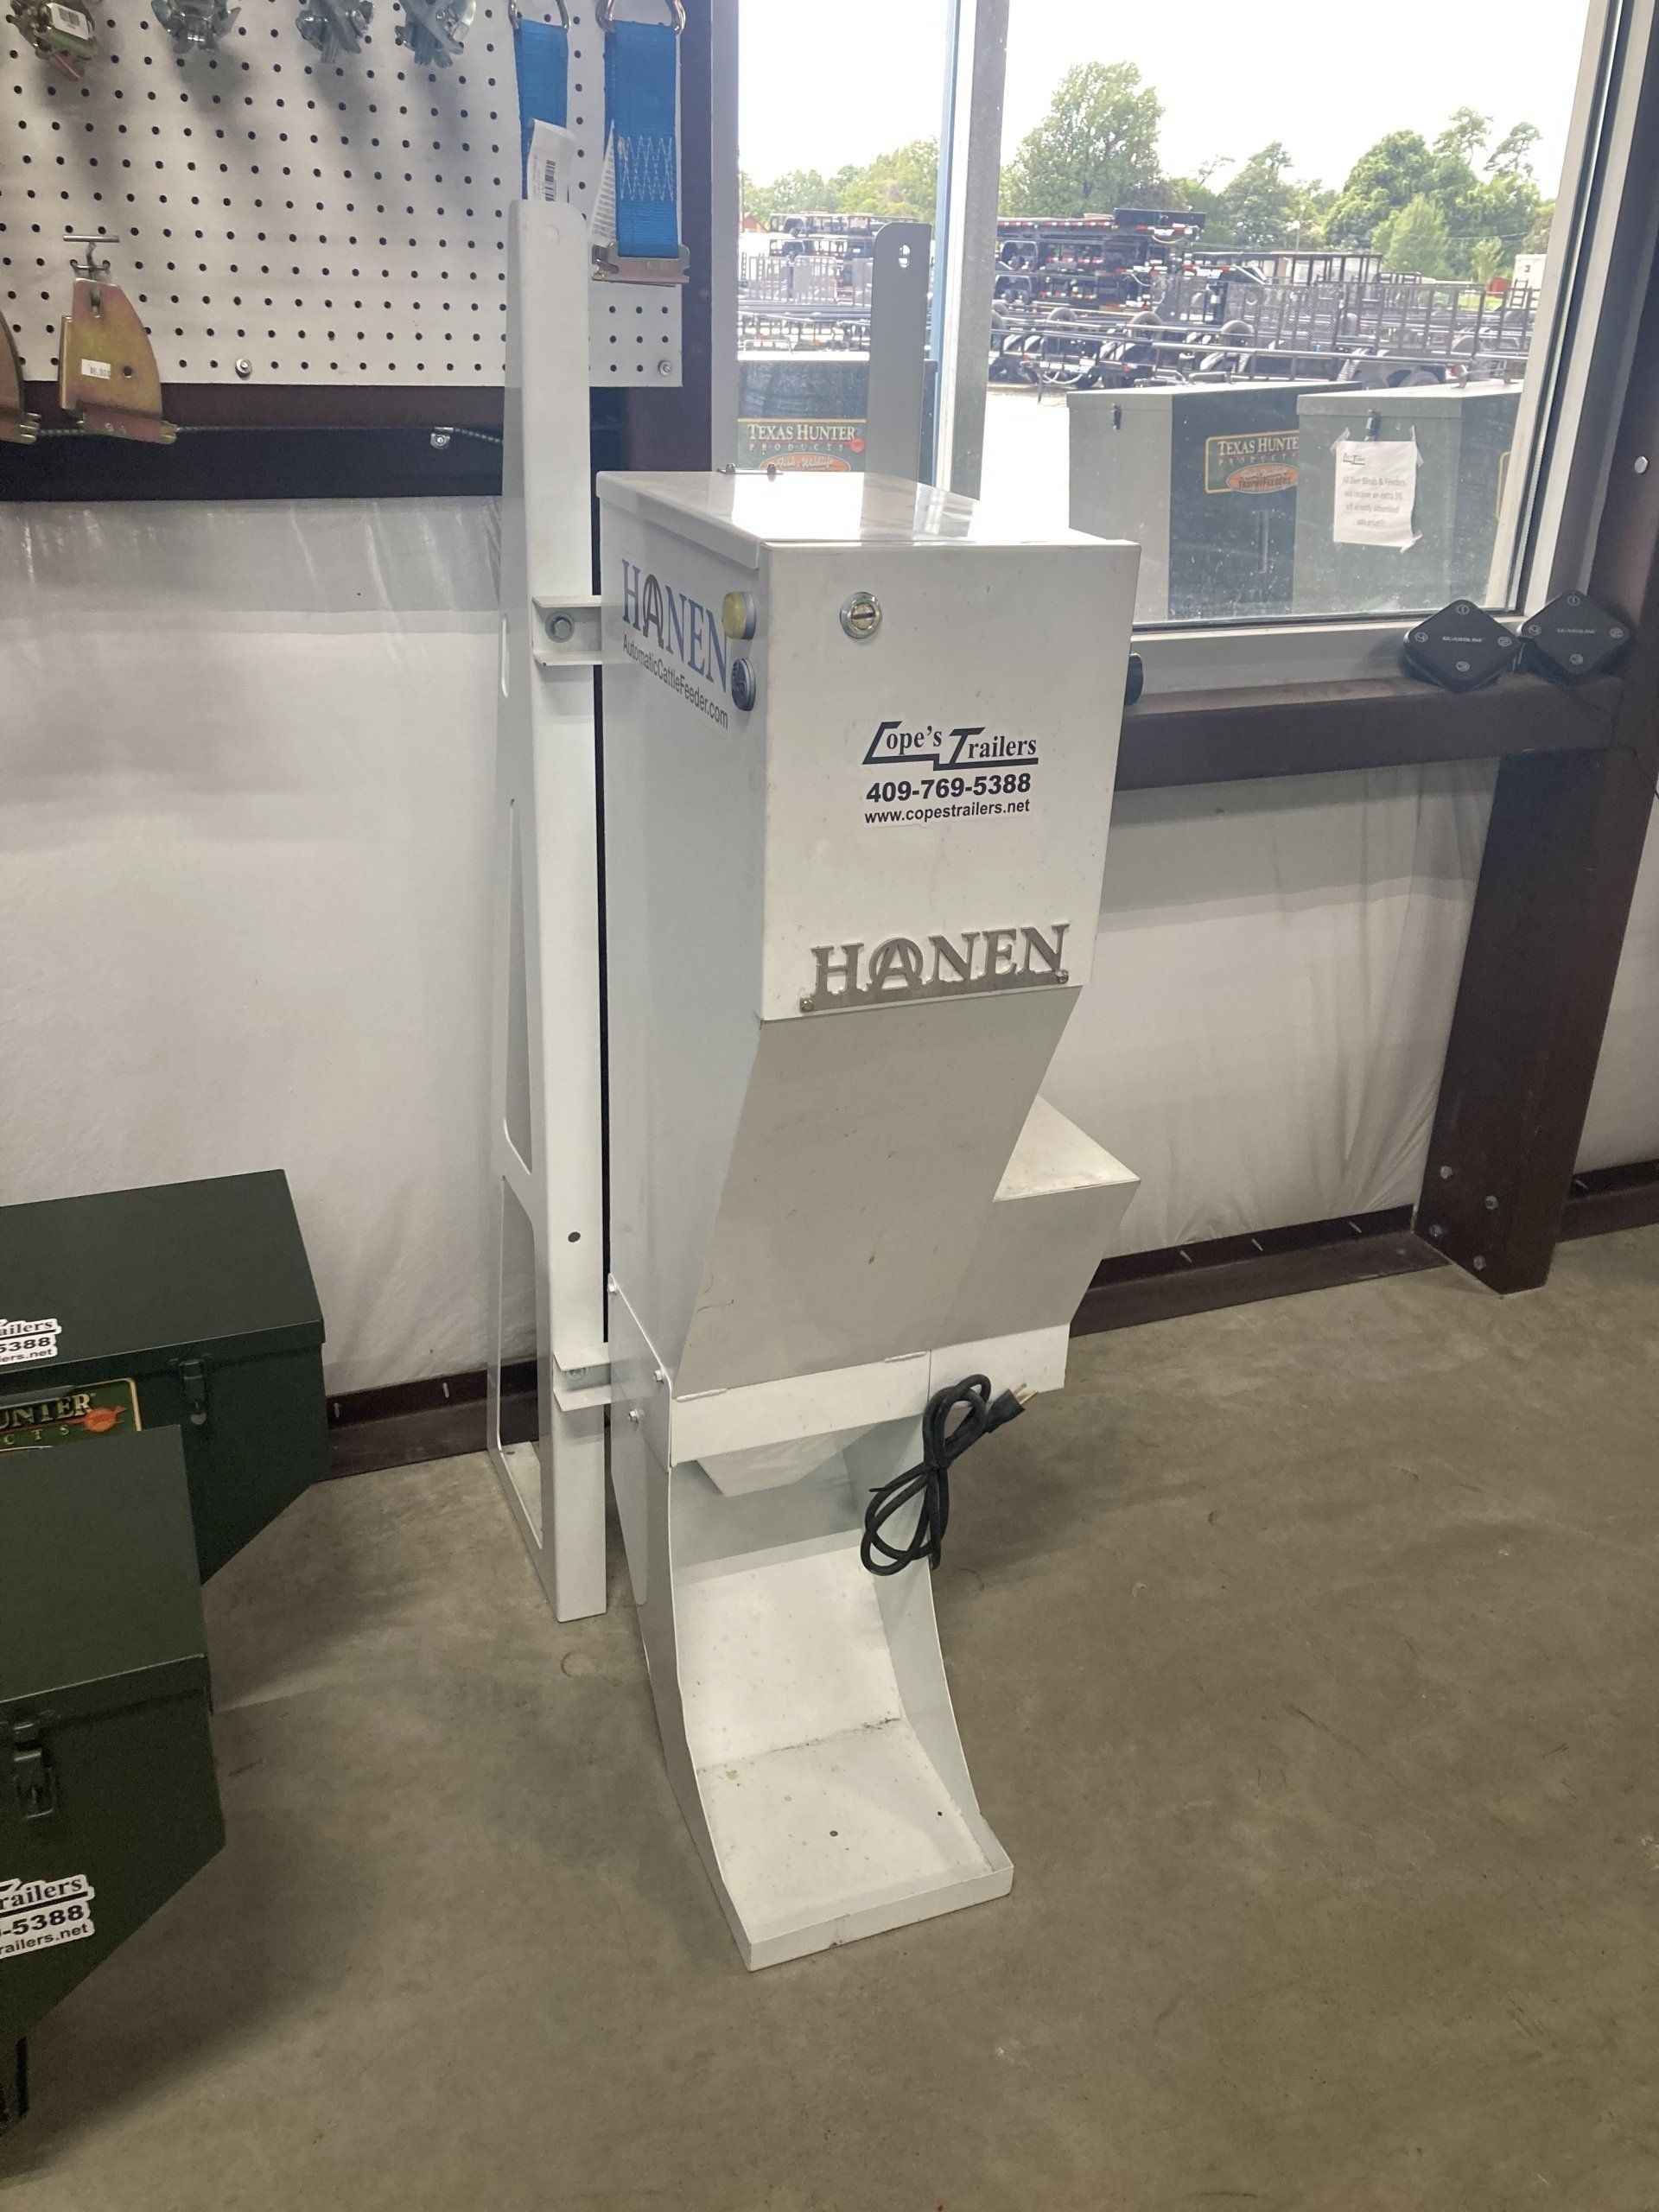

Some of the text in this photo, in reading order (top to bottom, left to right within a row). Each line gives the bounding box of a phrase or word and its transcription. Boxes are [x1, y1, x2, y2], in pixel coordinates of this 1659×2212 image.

[747, 424, 855, 441] TEXAS HUNTER
[749, 443, 843, 452] PRODUCTS
[1217, 441, 1255, 456] TEXAS
[621, 559, 727, 693] HANEN
[623, 633, 728, 729] AutomaticCattleFeeder.com
[862, 721, 1039, 768] Cope's Trailers
[866, 773, 1031, 803] 409-769-5388
[865, 799, 1030, 823] www.copestrailers.net
[810, 924, 1071, 996] HANEN
[0, 1321, 53, 1336] ailers
[0, 1905, 84, 1937] -5388
